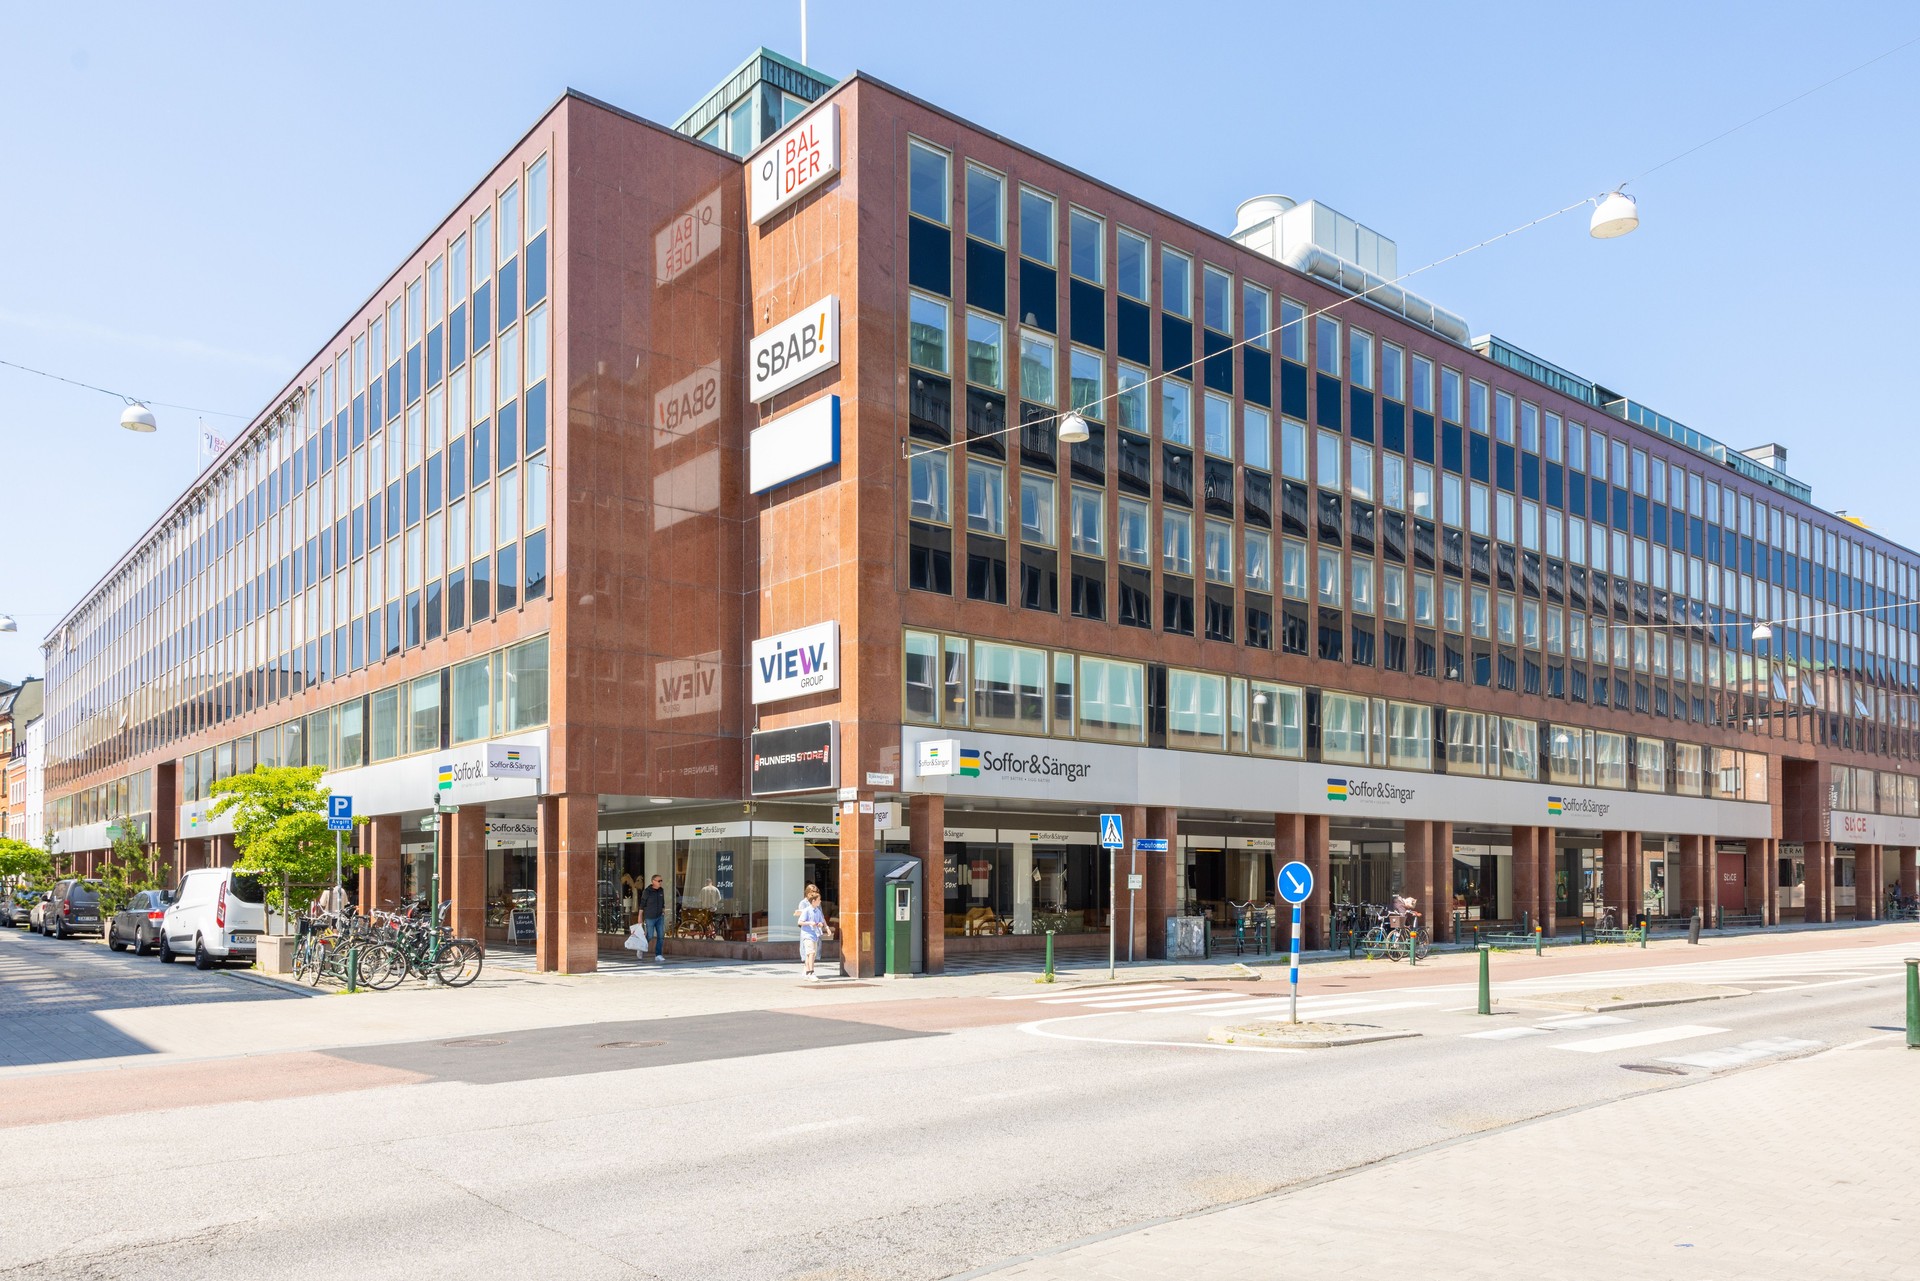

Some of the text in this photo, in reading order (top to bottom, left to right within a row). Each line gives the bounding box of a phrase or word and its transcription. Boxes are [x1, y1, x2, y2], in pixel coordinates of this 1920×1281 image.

[785, 124, 820, 166] BAL
[785, 150, 821, 195] DER
[756, 312, 826, 382] SBAB!
[800, 674, 824, 689] GROUP
[489, 760, 536, 771] Soffor&Sängar
[759, 753, 797, 767] RUNNERS
[796, 749, 824, 762] STORE
[983, 750, 1091, 782] Soffor&Sängar
[1348, 780, 1415, 804] Soffor&Sängar
[335, 797, 348, 816] P
[1562, 797, 1610, 817] Soffor&Sängar
[491, 823, 538, 836] Soffor&Säng
[944, 829, 964, 838] &Sängar
[1136, 841, 1167, 849] P-automat
